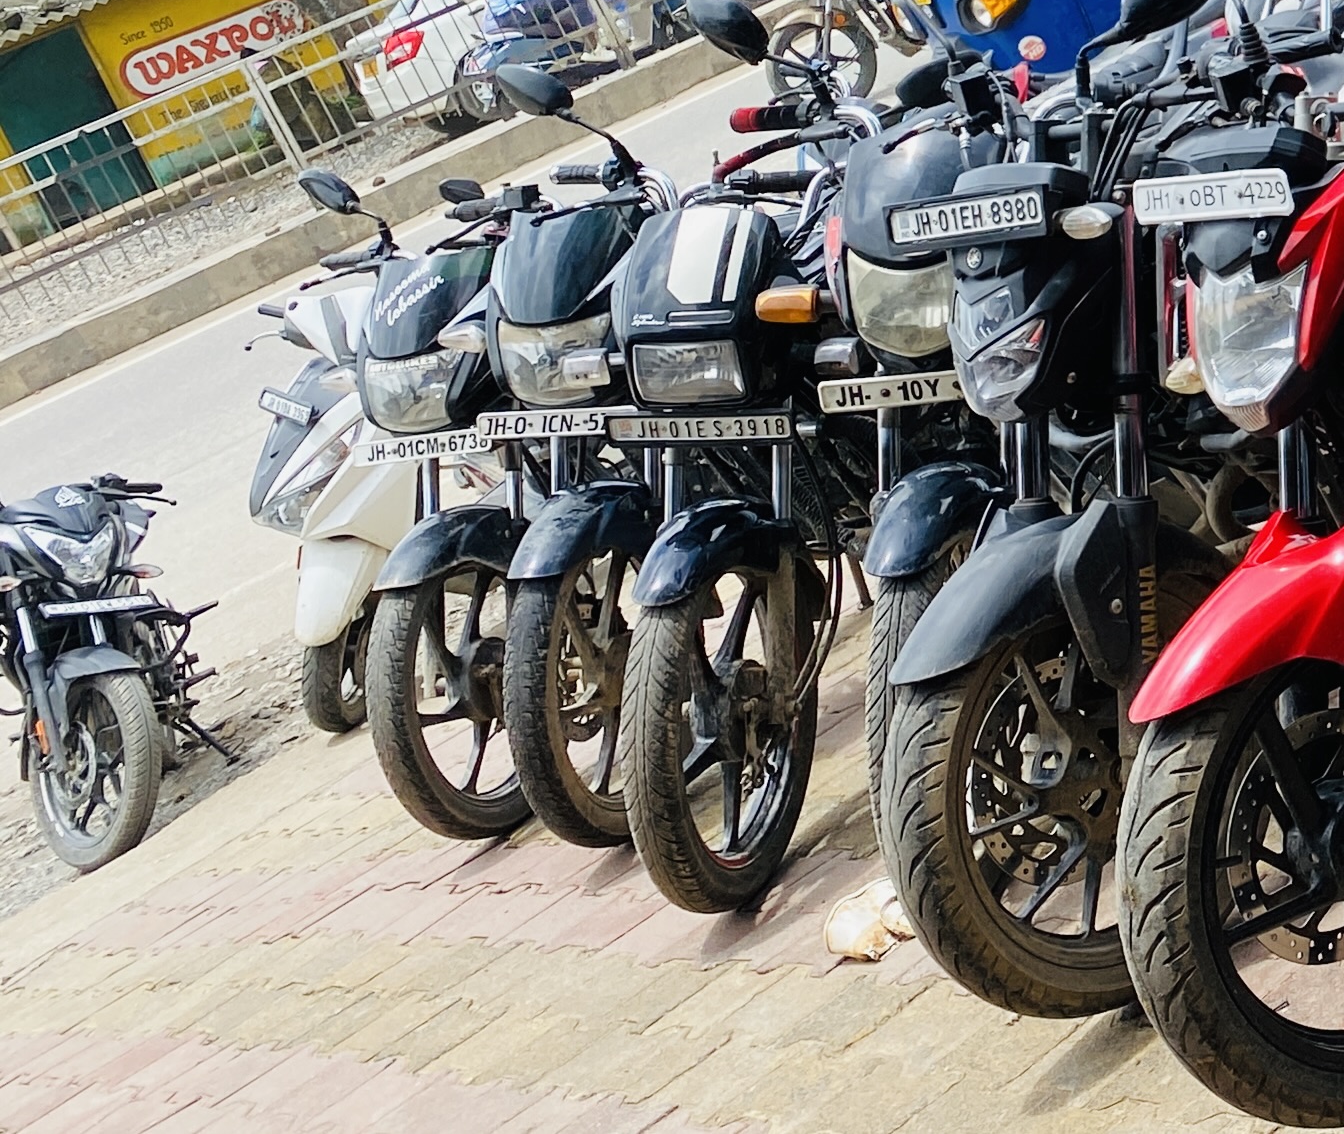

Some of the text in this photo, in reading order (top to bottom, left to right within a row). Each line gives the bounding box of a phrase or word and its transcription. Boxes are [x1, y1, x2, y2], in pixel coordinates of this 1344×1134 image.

[119, 29, 148, 46] Since
[133, 9, 296, 86] WAXPOL
[1138, 564, 1159, 665] YAMAHA
